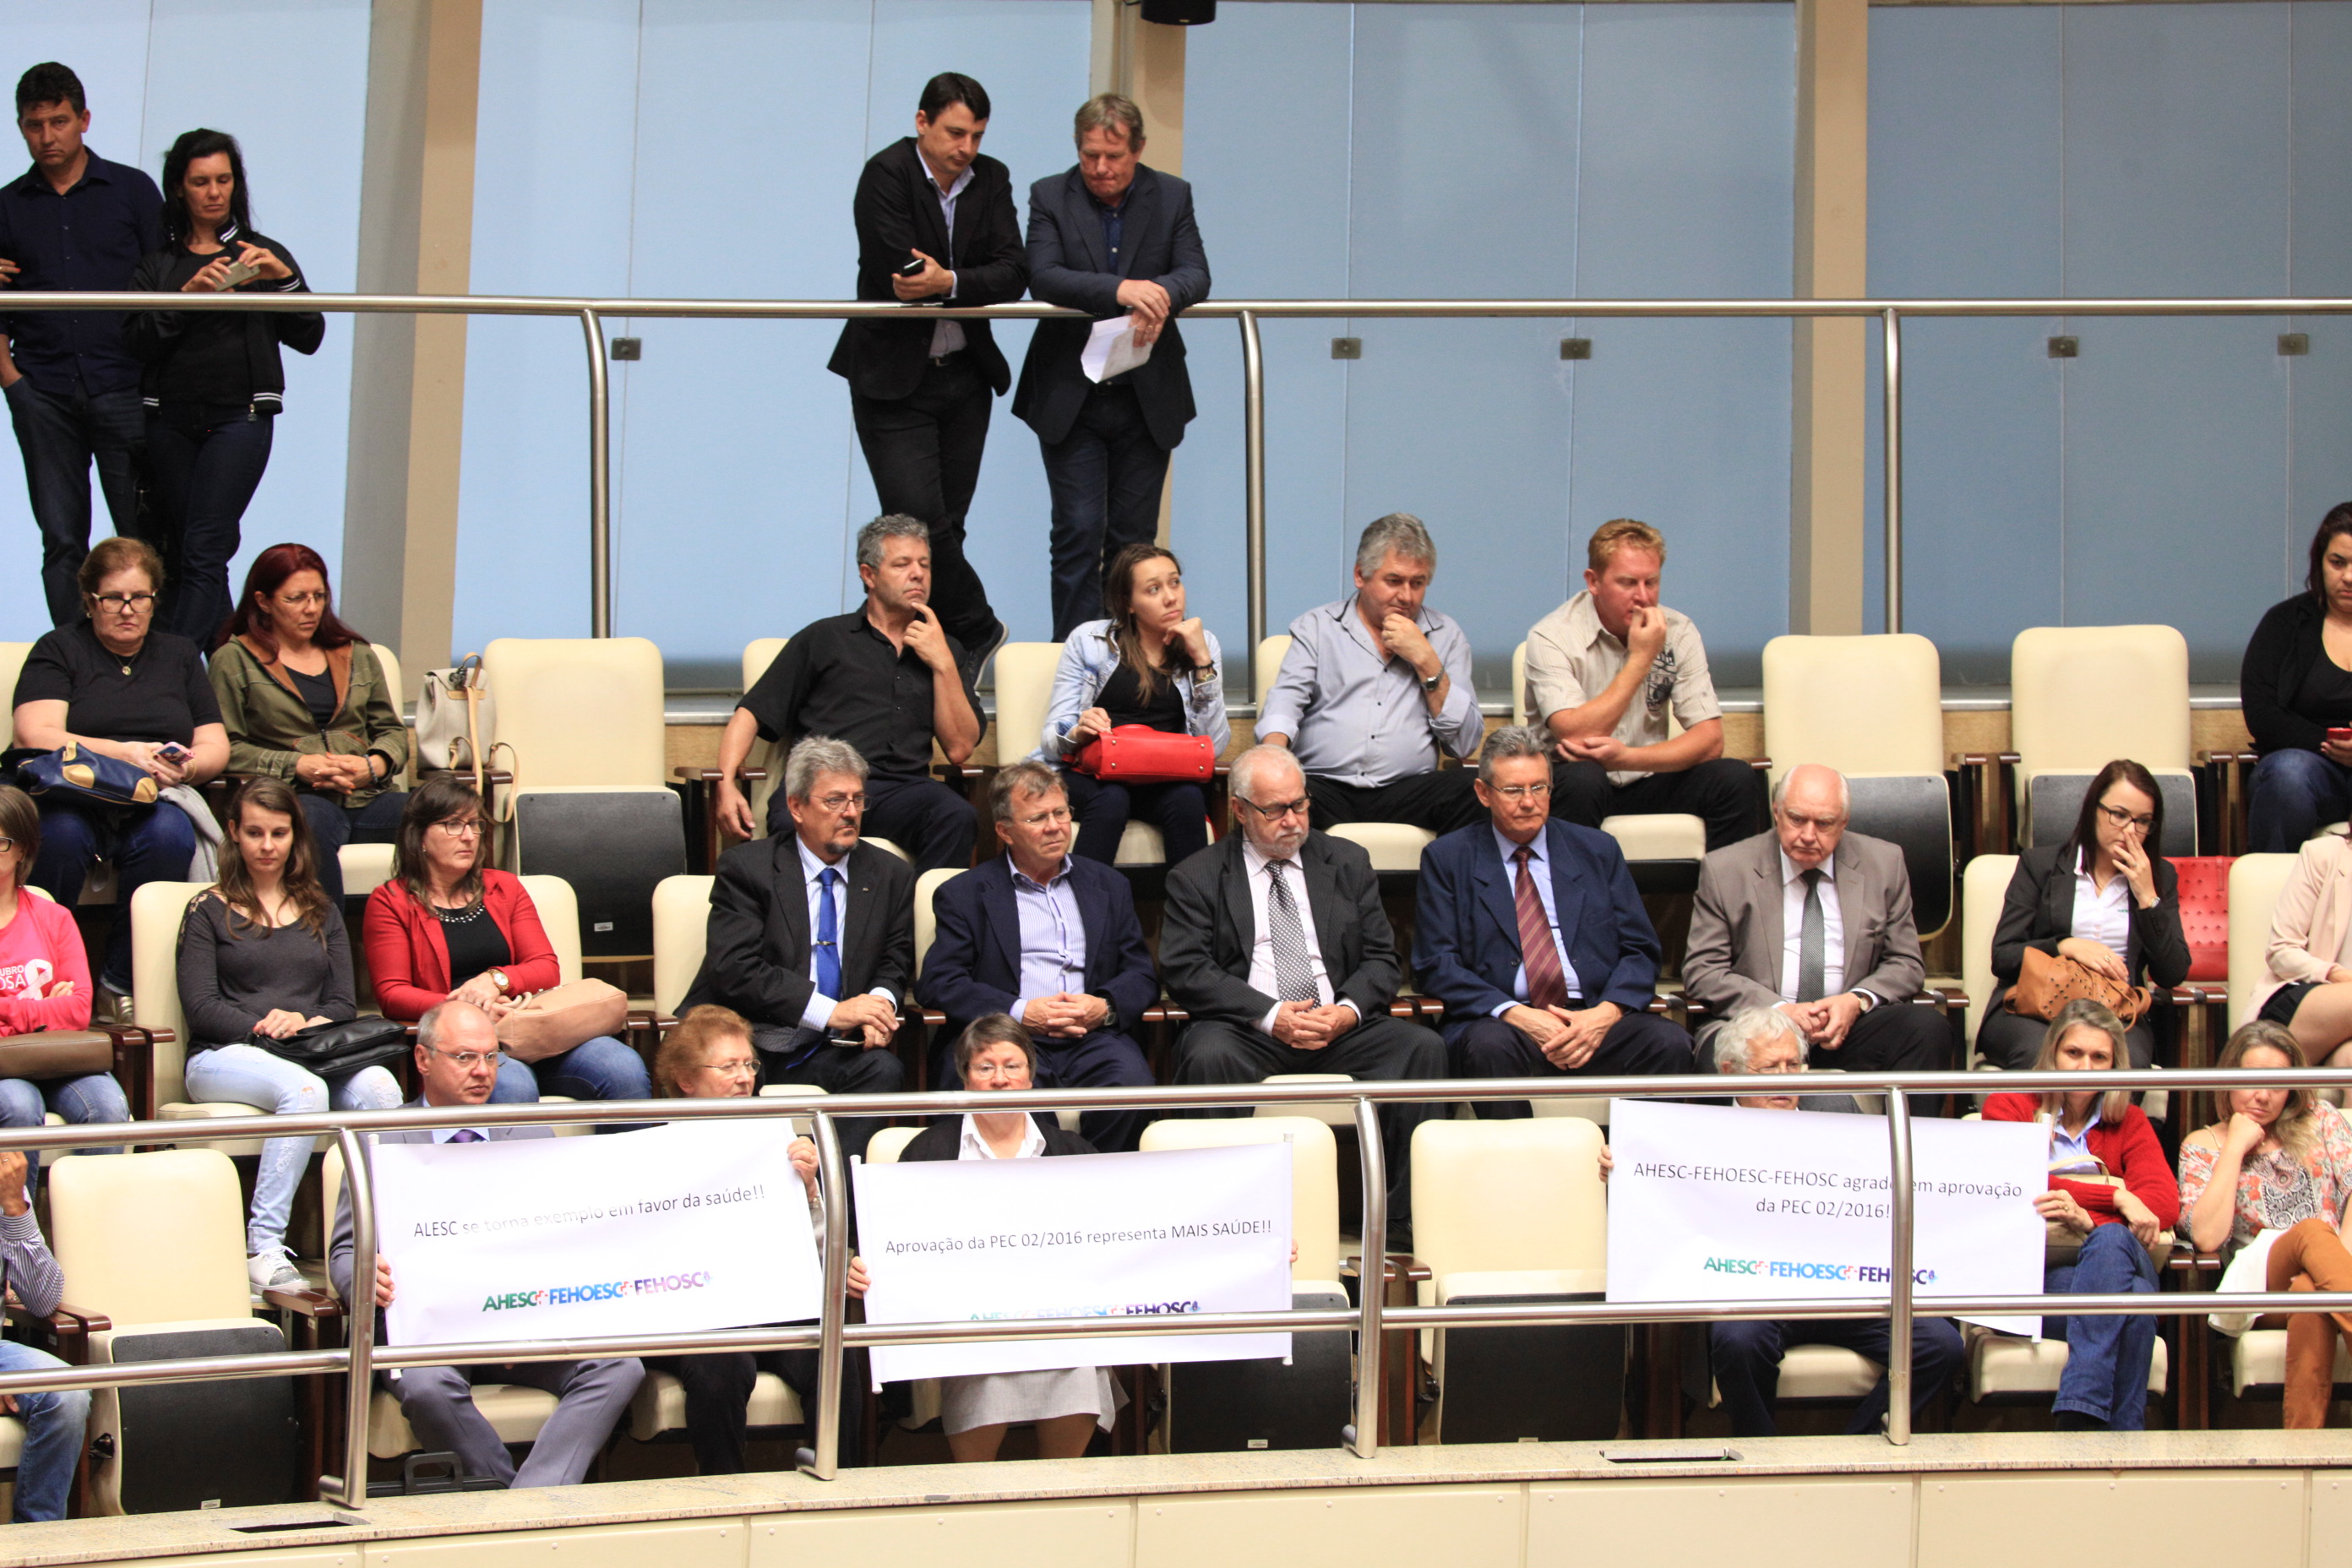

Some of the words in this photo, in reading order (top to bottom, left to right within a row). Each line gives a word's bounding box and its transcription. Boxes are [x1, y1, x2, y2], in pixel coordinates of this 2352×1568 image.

[1633, 1162, 1838, 1187] AHESC-FEHOESC-FEHOSC
[1938, 1182, 2022, 1199] aprovação
[414, 1221, 458, 1237] ALESC
[462, 1223, 478, 1234] se
[484, 1217, 529, 1232] torna
[534, 1206, 603, 1225] exemplo
[609, 1204, 634, 1217] em
[638, 1198, 678, 1214] favor
[683, 1193, 700, 1208] da
[705, 1184, 765, 1206] saúde!!
[1756, 1198, 1775, 1212] da
[1781, 1200, 1811, 1214] PEC
[885, 1238, 963, 1255] Aprovação
[968, 1236, 985, 1249] da
[990, 1234, 1017, 1248] PEC
[1021, 1231, 1082, 1248] 02/2016
[1087, 1228, 1167, 1244] representa
[1171, 1224, 1208, 1239] MAIS
[1212, 1219, 1271, 1236] SAÚDE!!
[1703, 1257, 1757, 1275] AHESC
[1769, 1261, 1846, 1281] FEHOESC
[482, 1290, 537, 1312] AHESC
[549, 1282, 623, 1305] FEHOESC
[634, 1271, 704, 1296] FEHOSC
